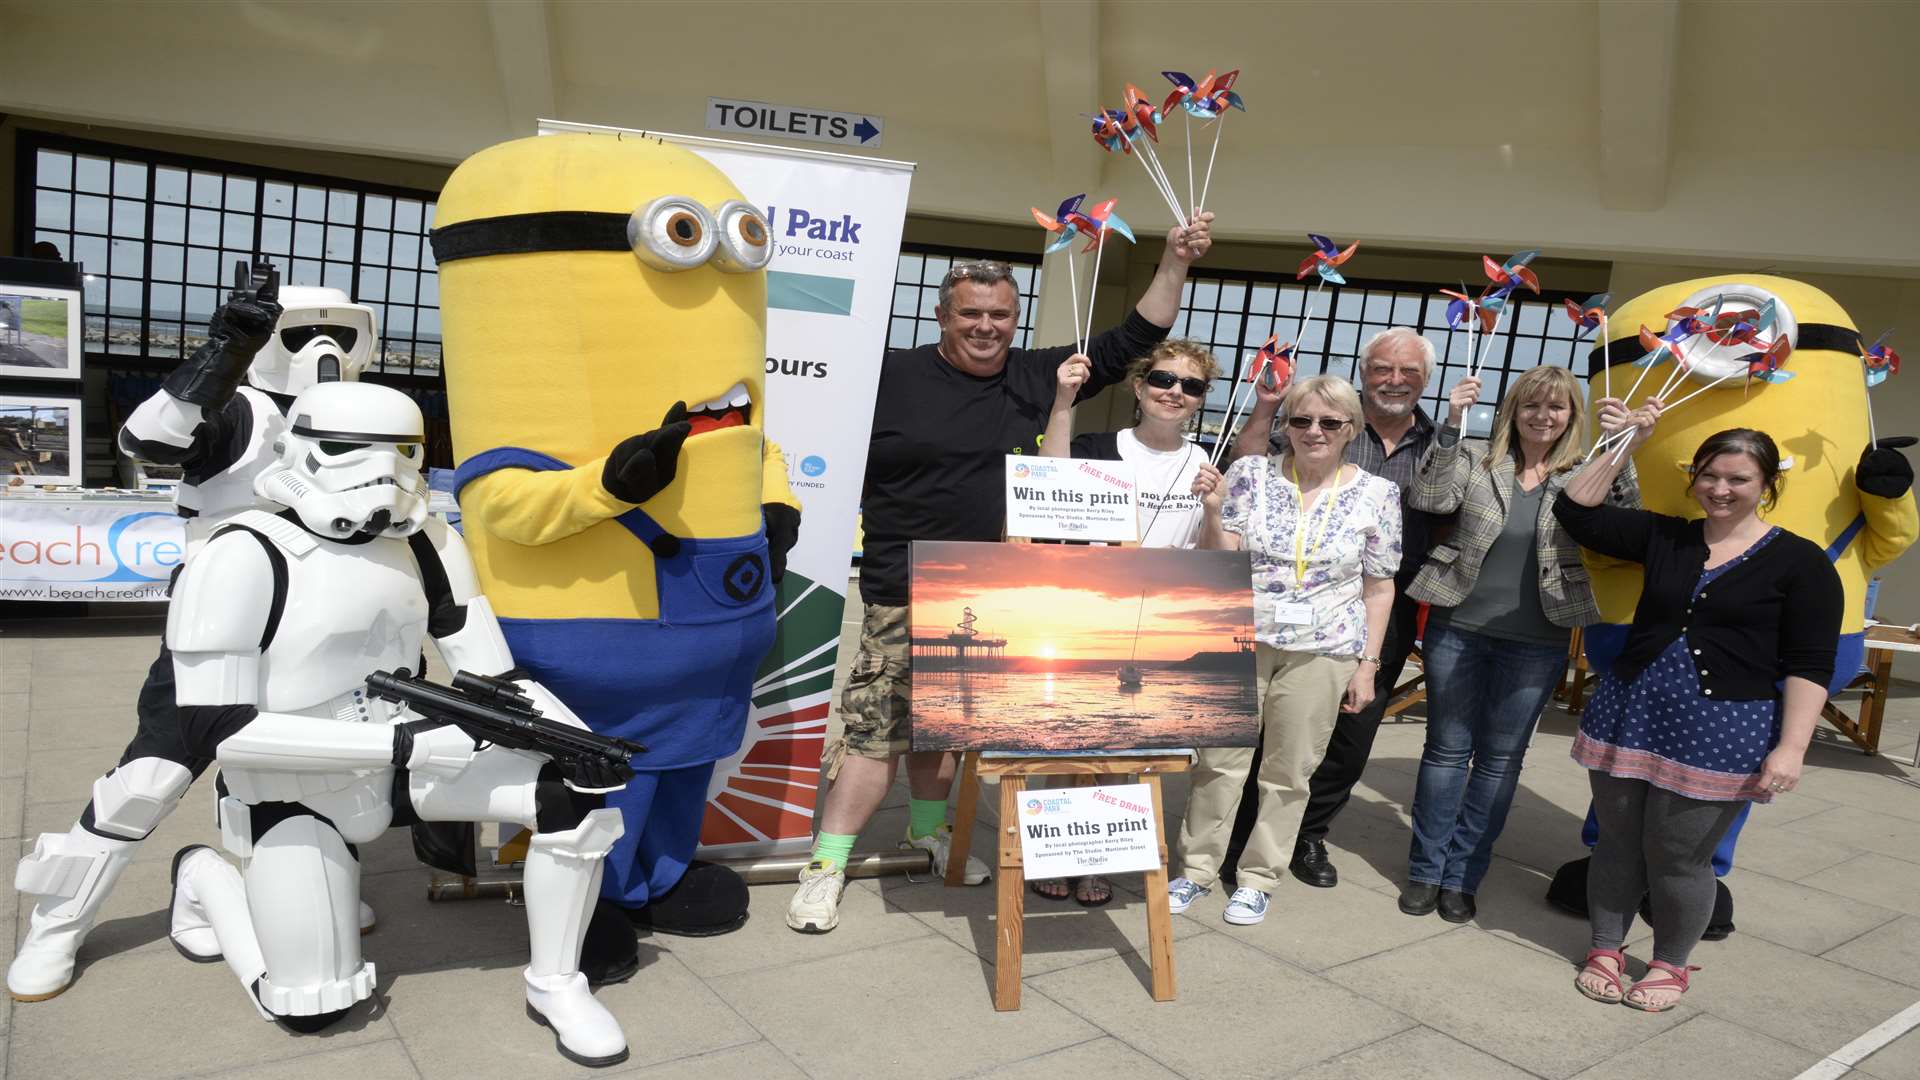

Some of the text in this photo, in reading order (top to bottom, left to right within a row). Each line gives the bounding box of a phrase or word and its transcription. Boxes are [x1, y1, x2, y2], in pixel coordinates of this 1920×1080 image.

[714, 103, 848, 139] TOILETS
[785, 207, 862, 245] Park
[779, 244, 855, 262] your coast
[796, 481, 825, 489] FUNDED
[1079, 463, 1133, 490] FREE DRAW!
[1013, 486, 1129, 506] Win this print
[1092, 791, 1150, 815] FREE DRAW!
[1026, 817, 1148, 839] Win this print
